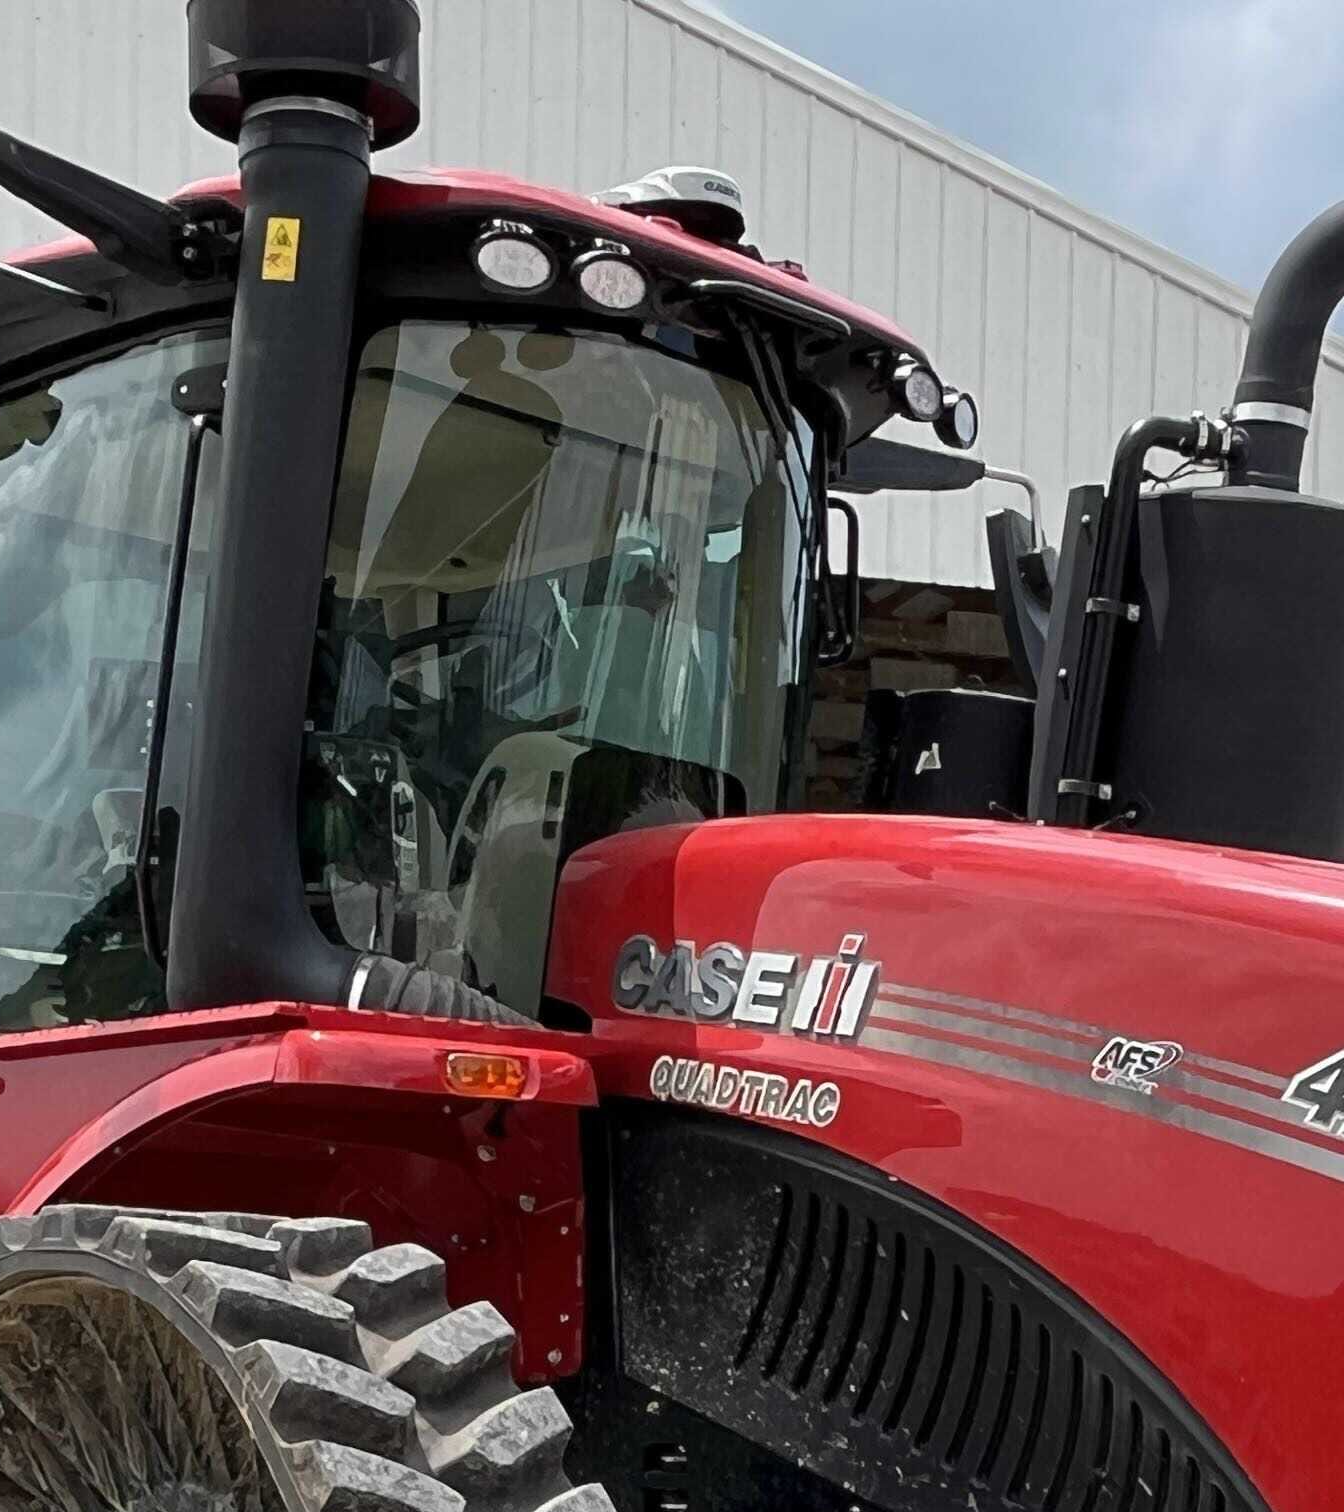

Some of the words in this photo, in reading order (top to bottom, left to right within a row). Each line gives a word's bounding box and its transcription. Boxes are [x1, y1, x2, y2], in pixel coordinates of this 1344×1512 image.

[613, 934, 798, 1028] CASE
[649, 1055, 841, 1128] QUADTRAC
[1093, 1036, 1165, 1079] AFS
